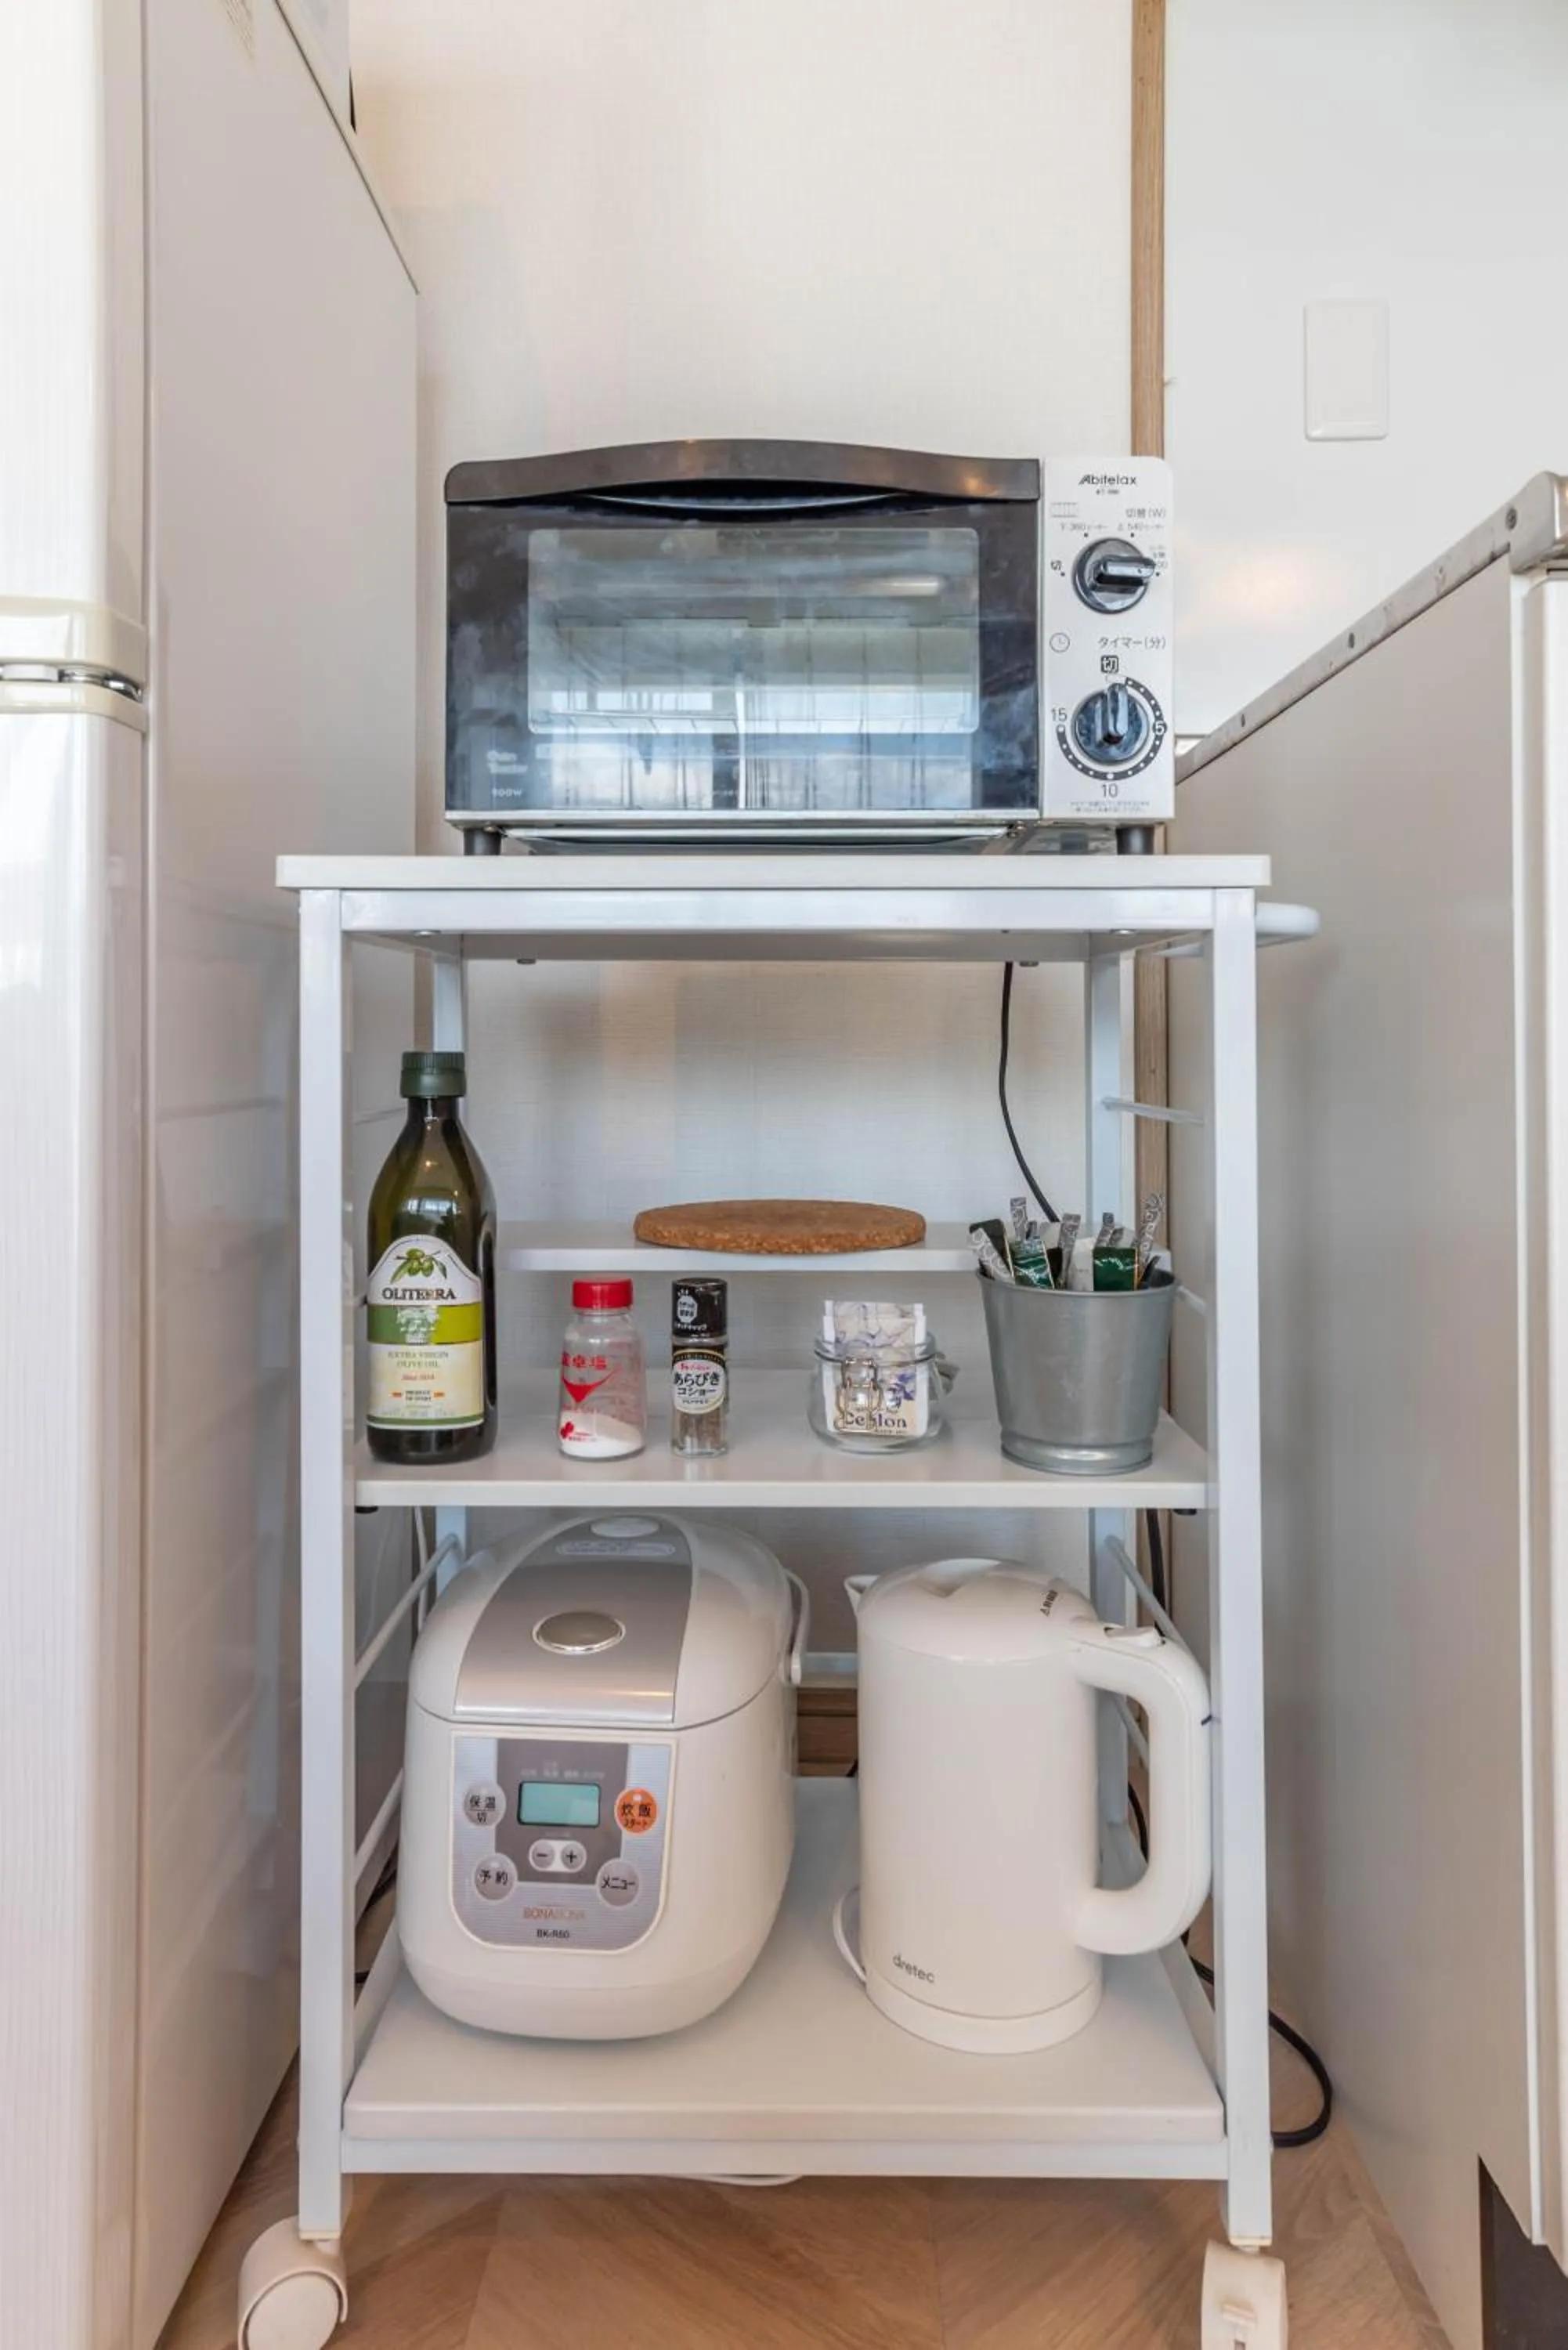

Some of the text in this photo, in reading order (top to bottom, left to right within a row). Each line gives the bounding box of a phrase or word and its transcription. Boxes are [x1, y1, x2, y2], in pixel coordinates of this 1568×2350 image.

[1078, 474, 1137, 486] Abitelax
[1097, 636, 1166, 649] タイマー(分)
[1102, 656, 1118, 673] 切
[1051, 707, 1068, 721] 15
[1154, 723, 1165, 736] 5
[1101, 784, 1118, 798] 10
[381, 1287, 457, 1300] OLITERRA
[674, 1372, 720, 1386] あらびき
[677, 1387, 717, 1397] コショー
[469, 1795, 497, 1809] 保温
[621, 1804, 652, 1817] 炊飯
[476, 1811, 487, 1824] 切
[479, 1870, 508, 1887] 予約
[601, 1877, 636, 1890] メニュー
[892, 1953, 936, 1983] dretec
